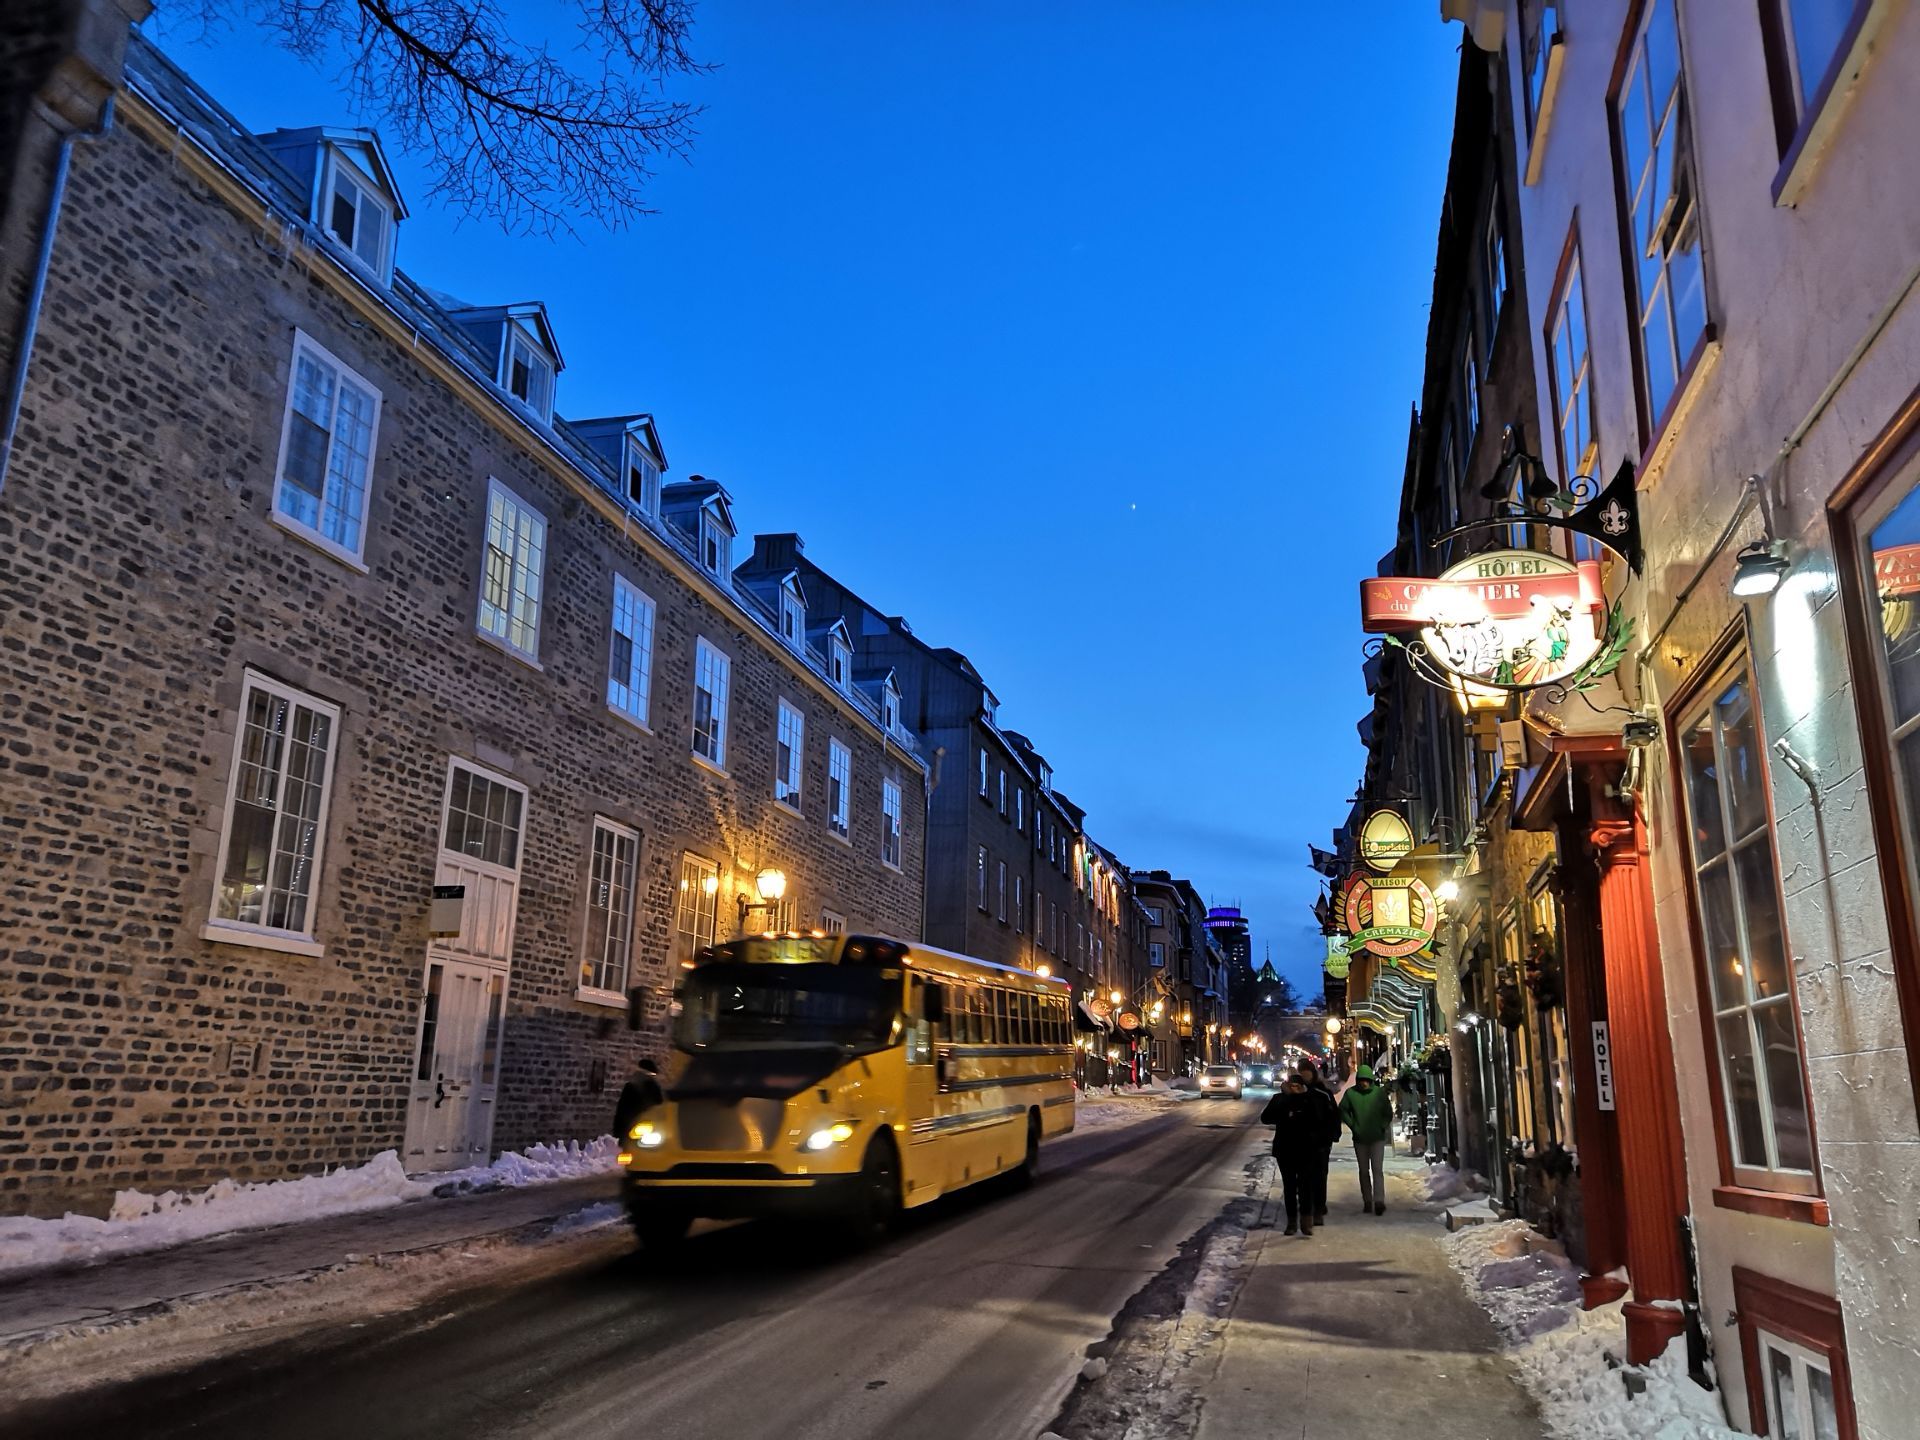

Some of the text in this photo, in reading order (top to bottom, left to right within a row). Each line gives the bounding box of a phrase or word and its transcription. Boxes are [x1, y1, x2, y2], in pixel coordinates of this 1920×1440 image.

[1478, 558, 1547, 578] HÔTEL
[1403, 583, 1521, 600] CAIER
[1391, 600, 1408, 612] du
[1374, 944, 1413, 954] SOUVENIRS
[1595, 1028, 1610, 1103] HOTEL
